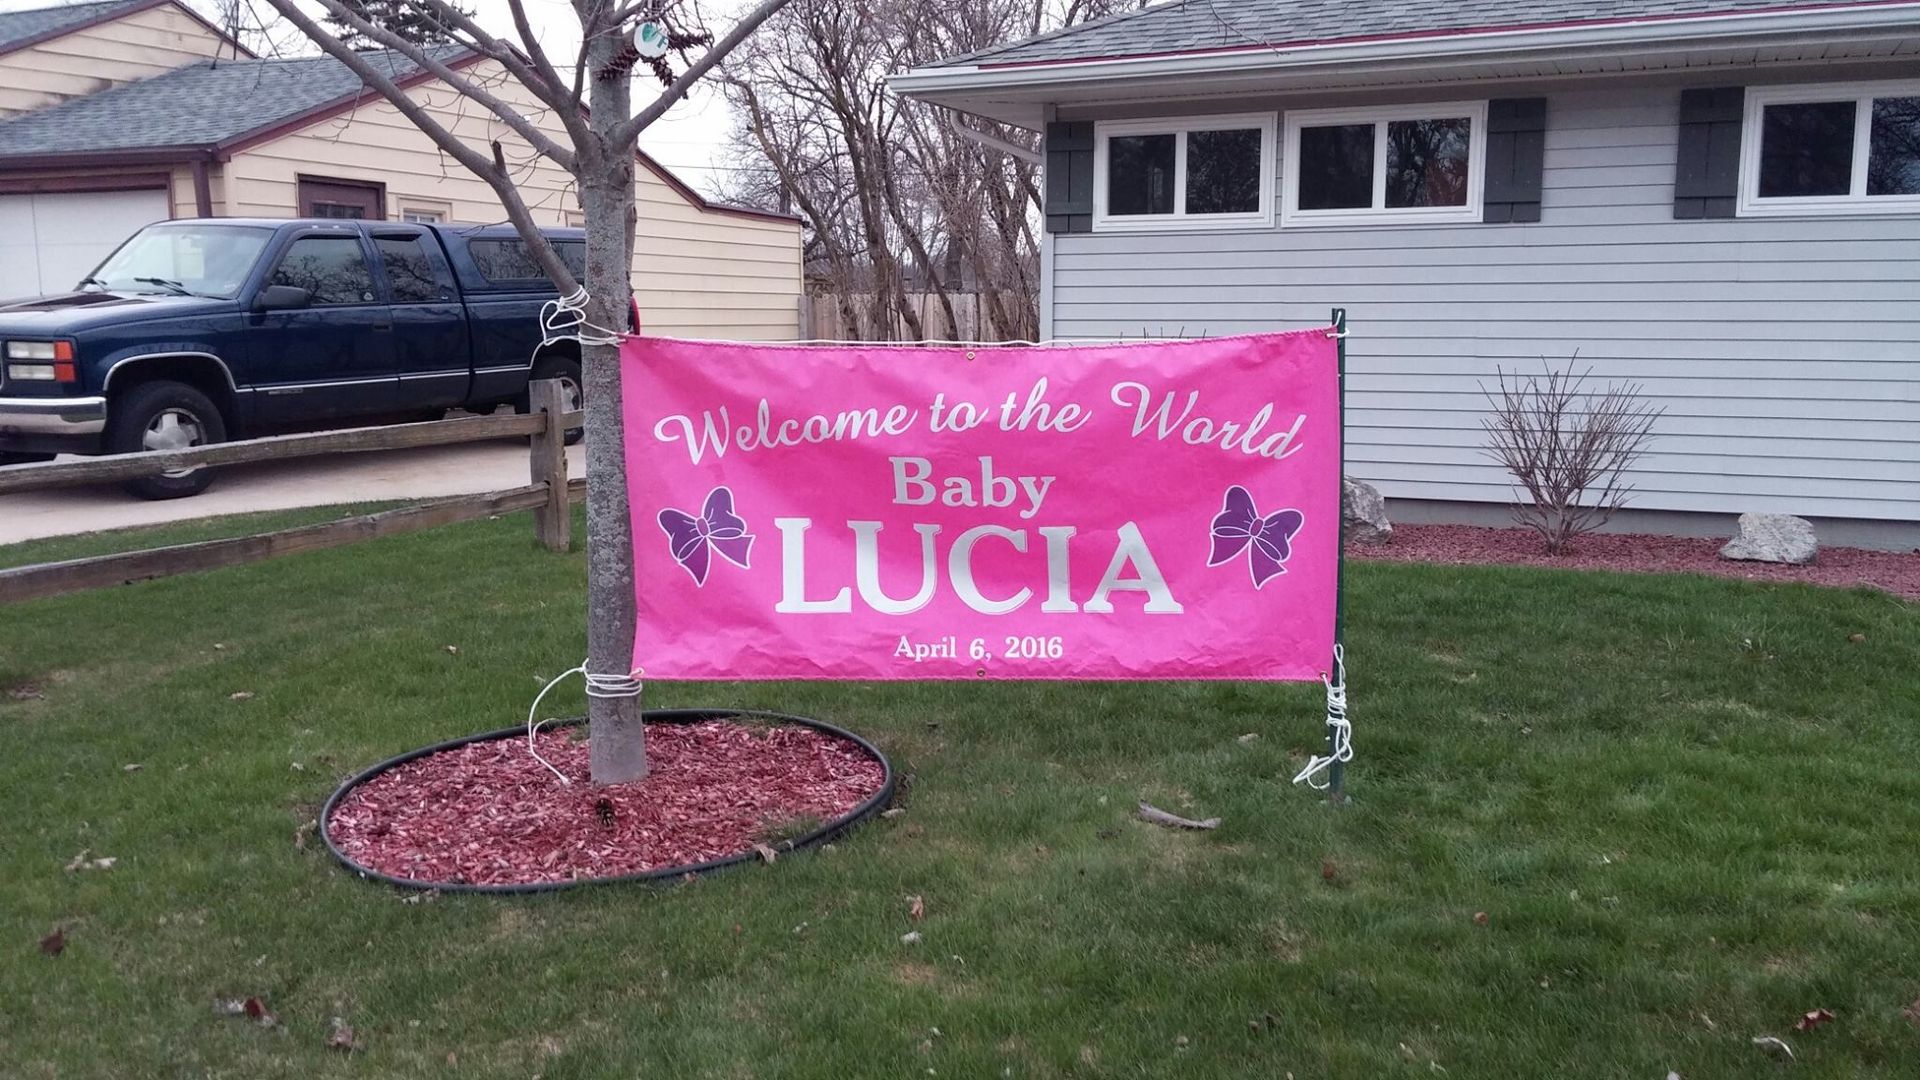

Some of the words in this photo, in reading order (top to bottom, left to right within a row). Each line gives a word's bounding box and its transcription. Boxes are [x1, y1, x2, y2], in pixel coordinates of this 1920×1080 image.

[653, 398, 918, 466] Welcome
[929, 392, 990, 432] to
[1000, 376, 1092, 434] the
[1110, 381, 1307, 460] World
[890, 456, 1056, 520] Baby
[774, 517, 1184, 615] LUCIA
[893, 635, 957, 662] April
[969, 637, 992, 662] 6,
[1004, 635, 1064, 660] 2016
